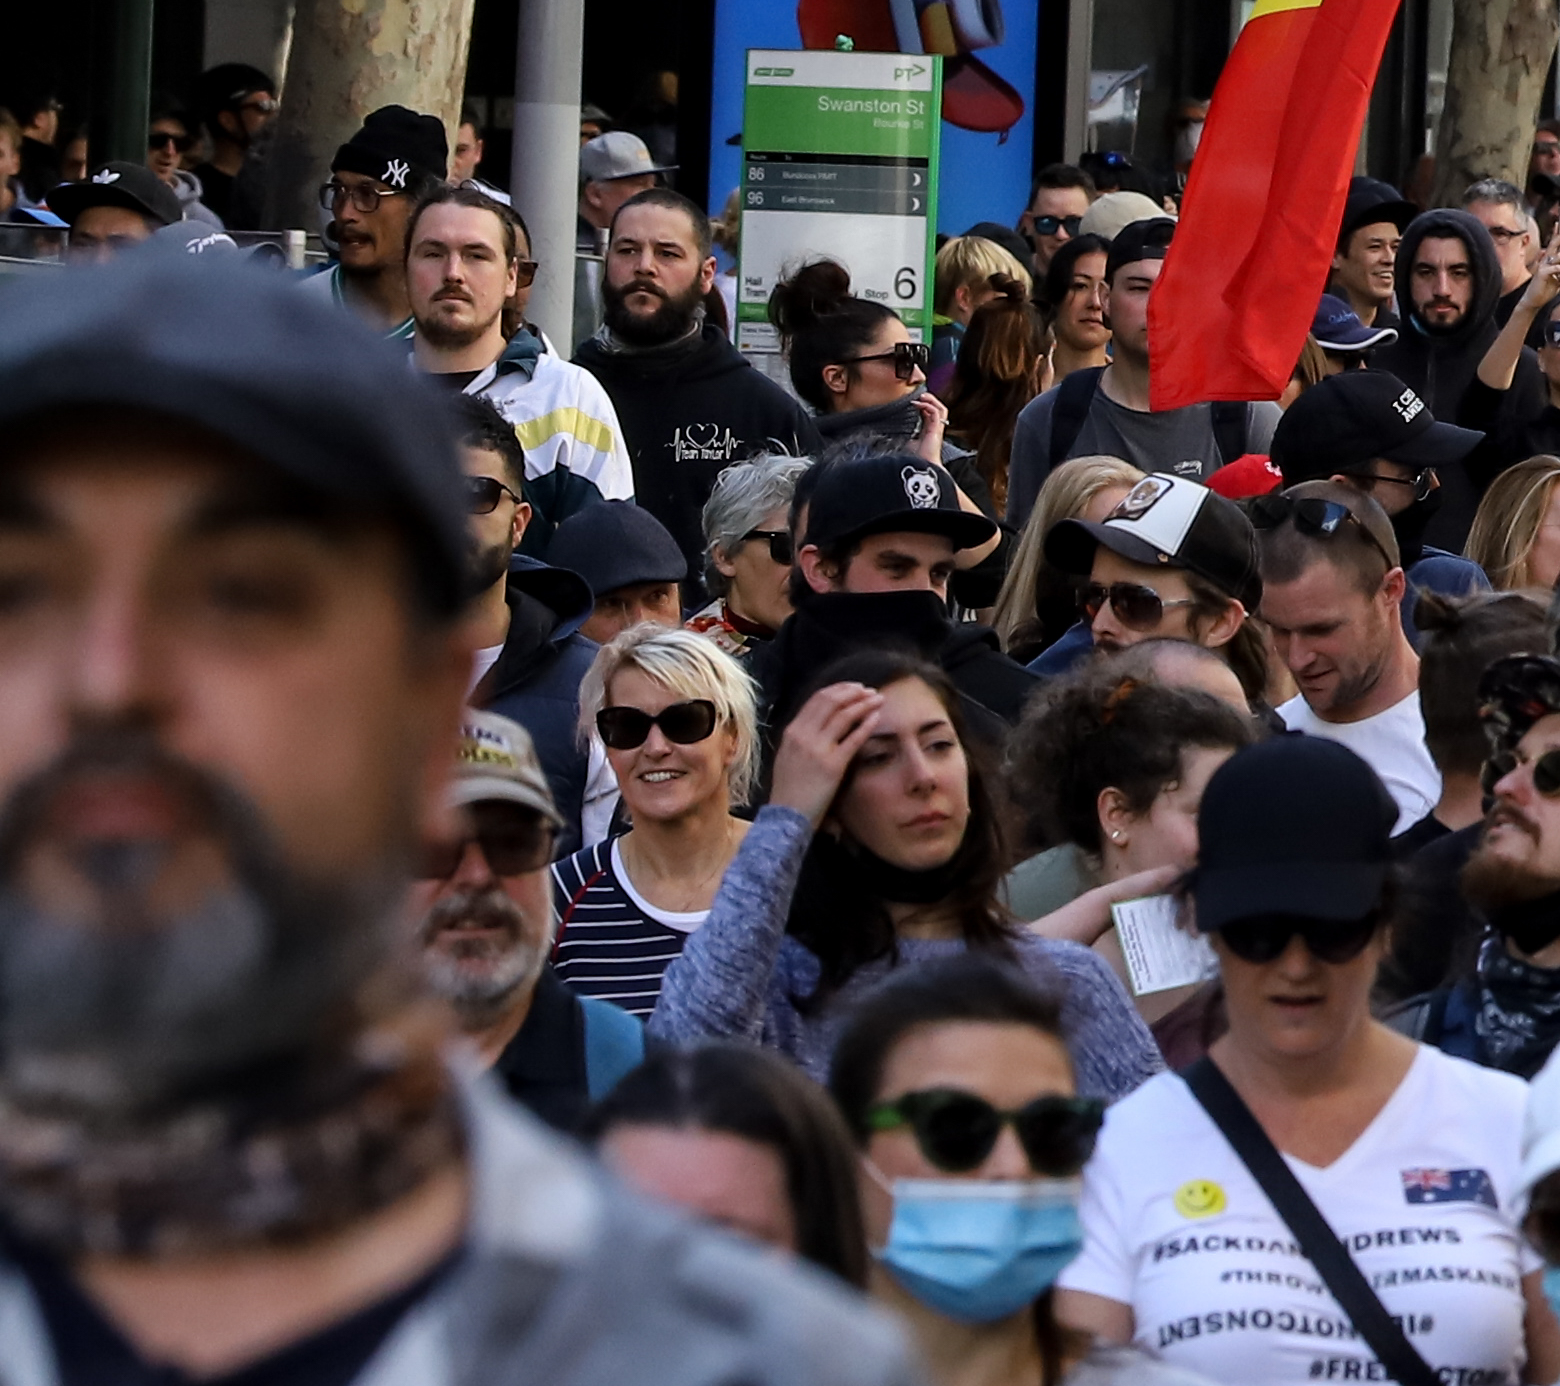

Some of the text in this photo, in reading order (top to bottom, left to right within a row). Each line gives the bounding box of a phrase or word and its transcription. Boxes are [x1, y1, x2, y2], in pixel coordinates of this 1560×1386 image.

[818, 96, 925, 115] Swanston St
[873, 118, 924, 130] Bourke St
[748, 167, 765, 181] 86
[747, 192, 764, 205] 96
[864, 267, 917, 301] Stop 6
